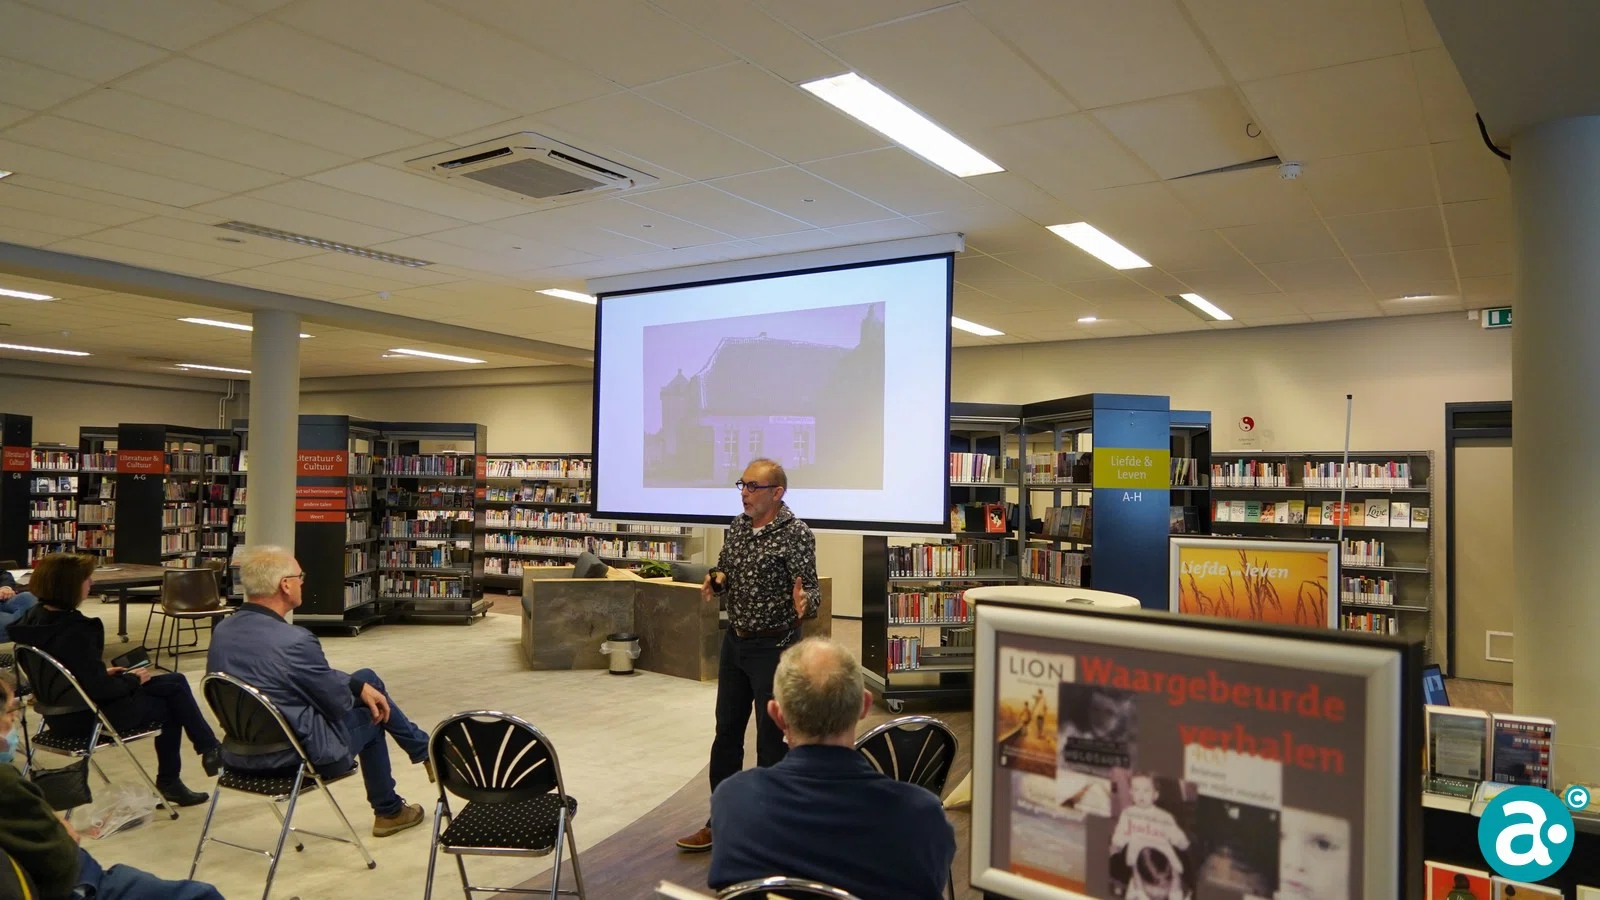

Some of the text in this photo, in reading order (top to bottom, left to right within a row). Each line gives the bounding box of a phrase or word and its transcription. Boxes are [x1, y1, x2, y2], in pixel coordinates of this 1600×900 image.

[297, 454, 343, 462] iteratuur &
[1111, 456, 1153, 467] Liefde &
[1117, 470, 1147, 480] Leven
[1122, 491, 1142, 502] A-H
[1367, 505, 1387, 518] Love
[1180, 561, 1227, 578] Liefde
[1245, 562, 1289, 578] leven
[1009, 656, 1063, 679] LION
[1081, 655, 1345, 722] Waargebeurde
[1178, 723, 1344, 776] verhalen
